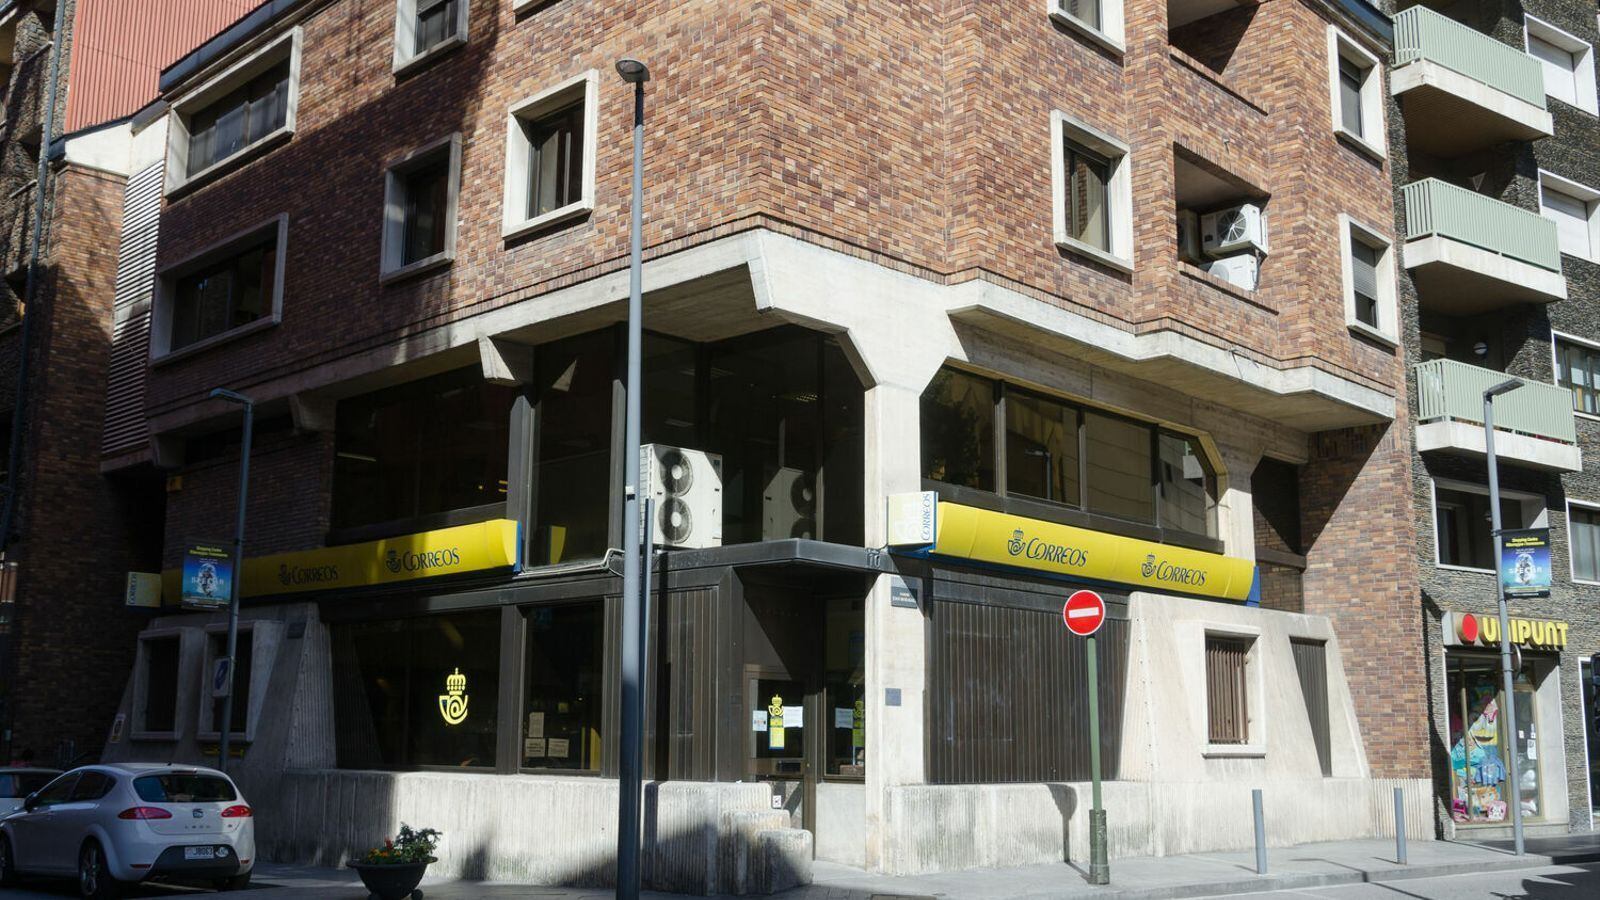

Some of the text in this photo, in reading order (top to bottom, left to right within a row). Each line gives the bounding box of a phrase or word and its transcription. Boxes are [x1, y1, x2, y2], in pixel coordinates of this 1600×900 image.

[921, 493, 931, 541] CORREOS
[402, 547, 460, 571] CORREOS
[1026, 537, 1089, 567] CORREOS
[291, 565, 338, 585] CORREOS
[1156, 560, 1208, 587] CORREOS
